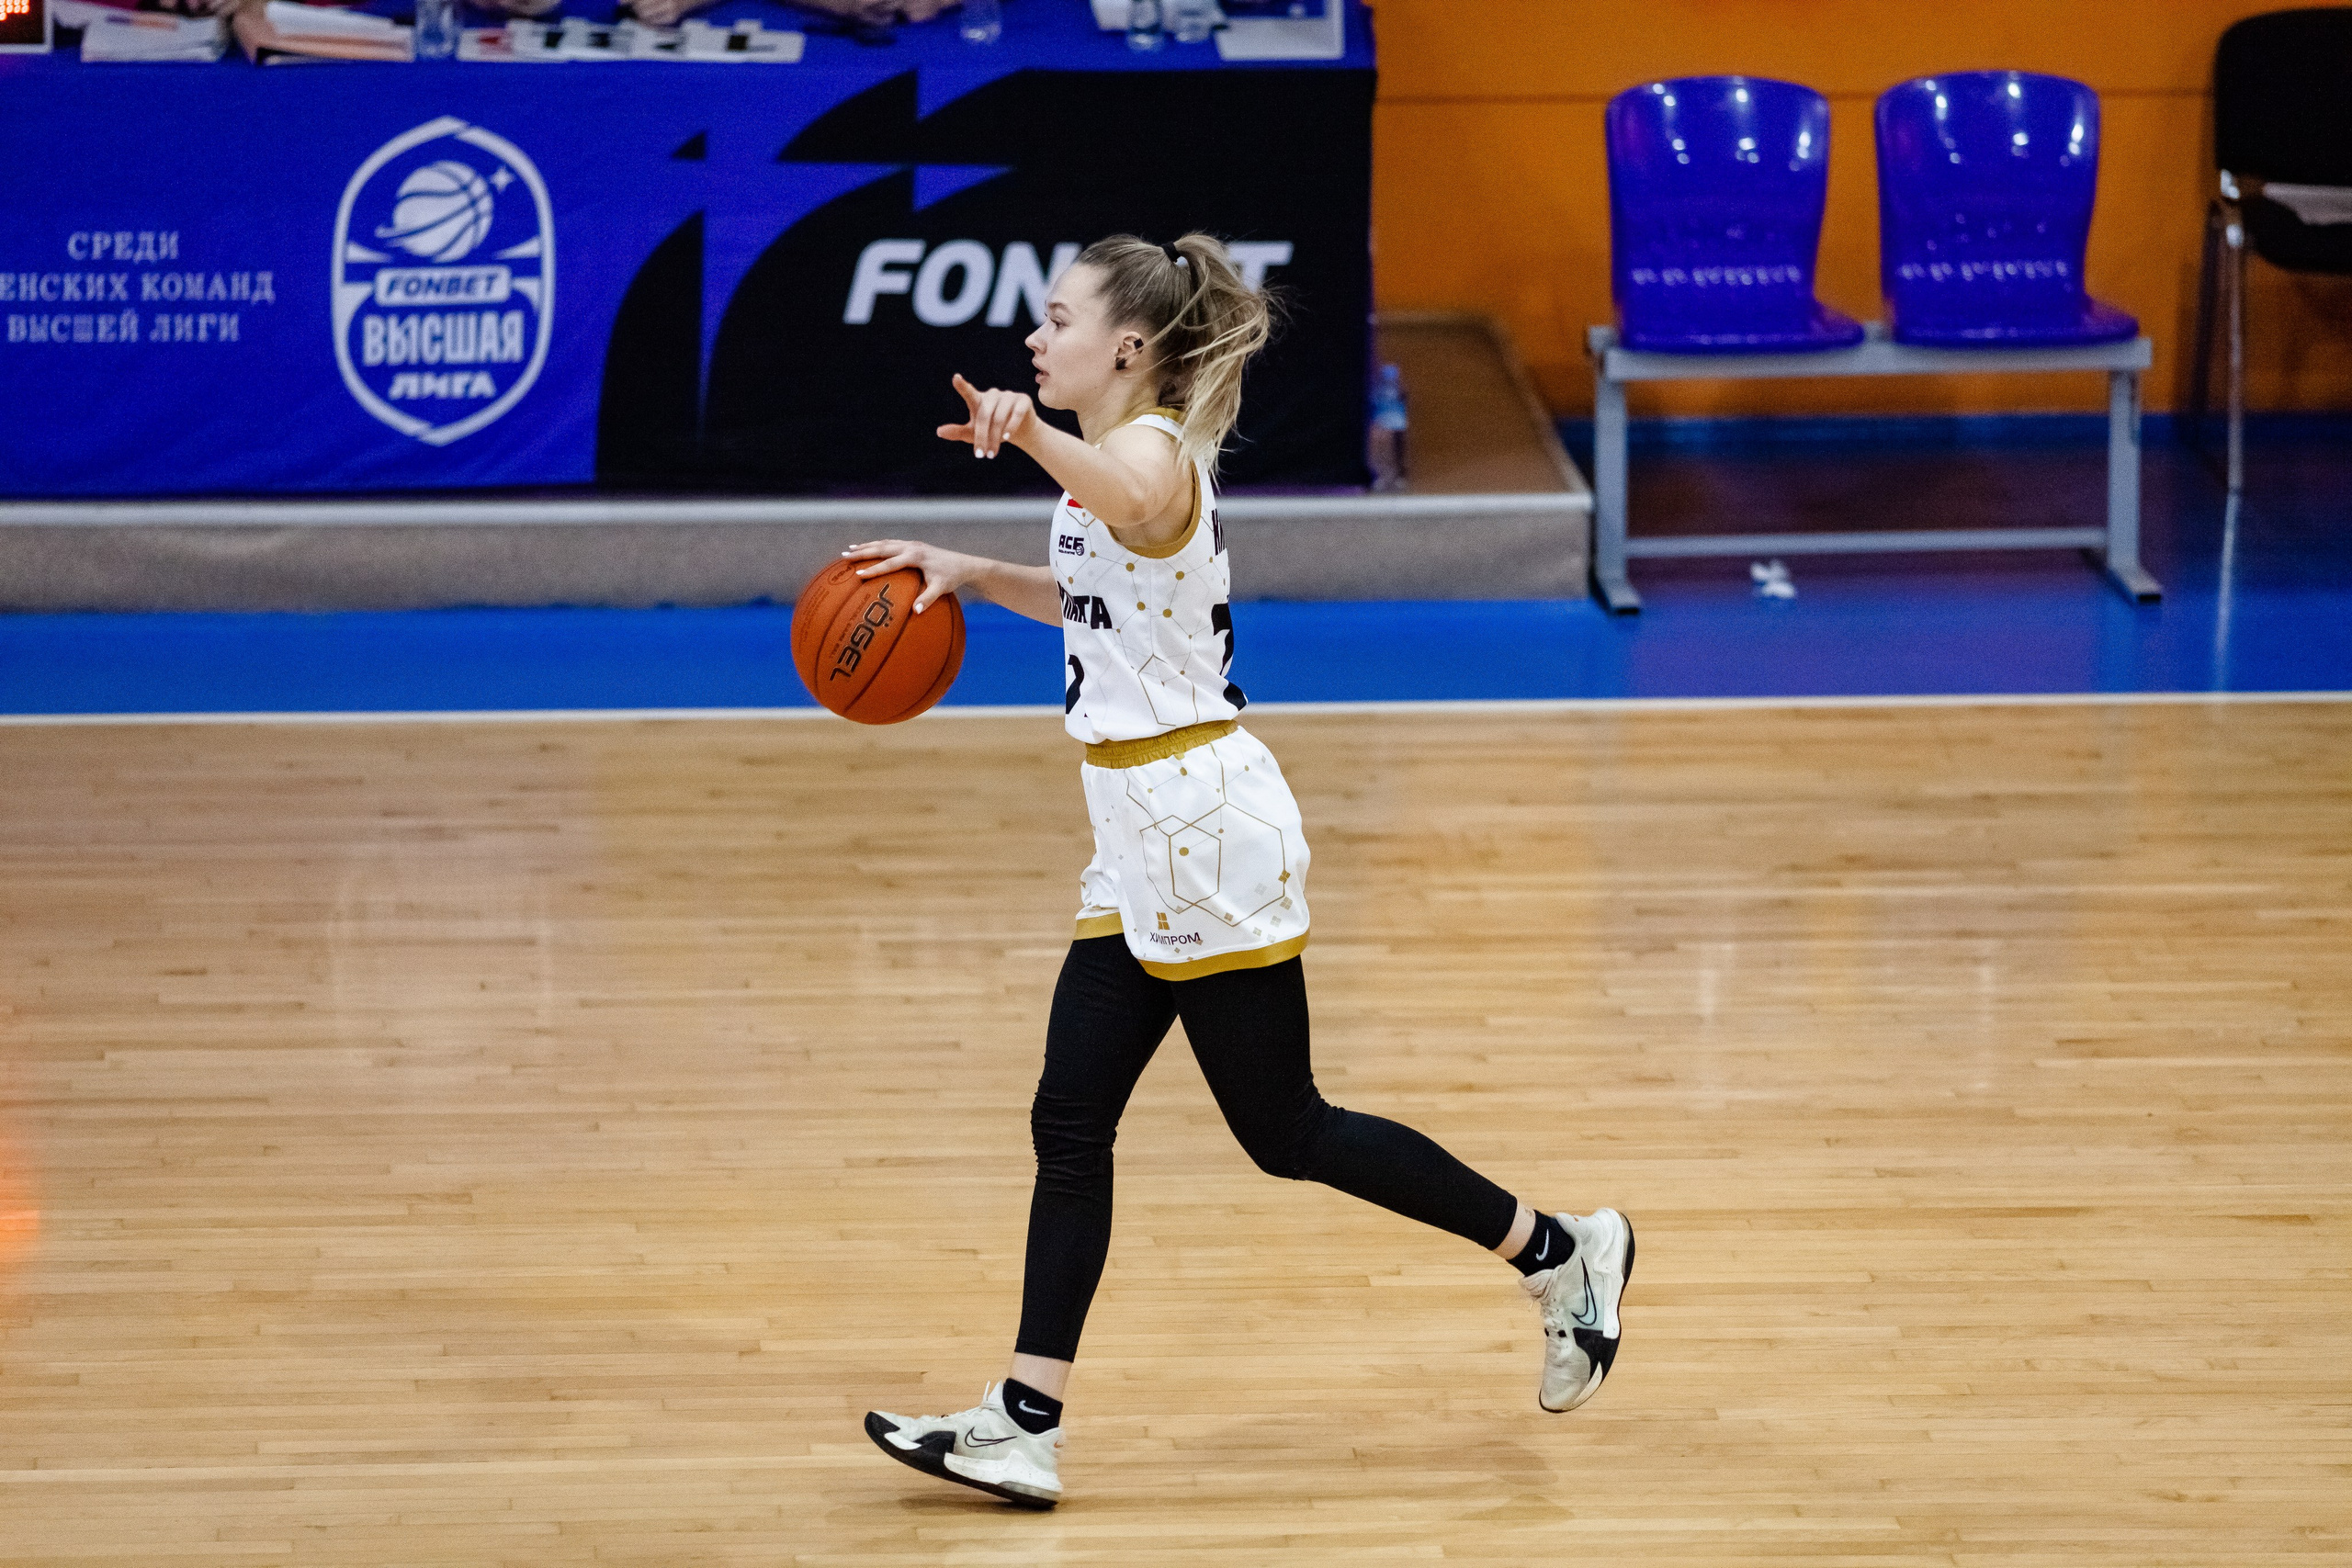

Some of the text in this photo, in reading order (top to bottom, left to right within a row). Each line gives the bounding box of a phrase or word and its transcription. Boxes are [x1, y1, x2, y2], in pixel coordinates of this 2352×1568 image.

[67, 231, 179, 264] СРЕДИ
[0, 271, 276, 306] ЕНСКИХ КОМАНД
[386, 274, 498, 297] FONBET
[842, 238, 1293, 327] FONT
[7, 307, 240, 343] ВЫСШЕЙ ЛИГИ
[363, 310, 525, 367] ВЫСШАЯ
[388, 370, 496, 400] ЛИГА
[830, 582, 895, 682] JÖGEL
